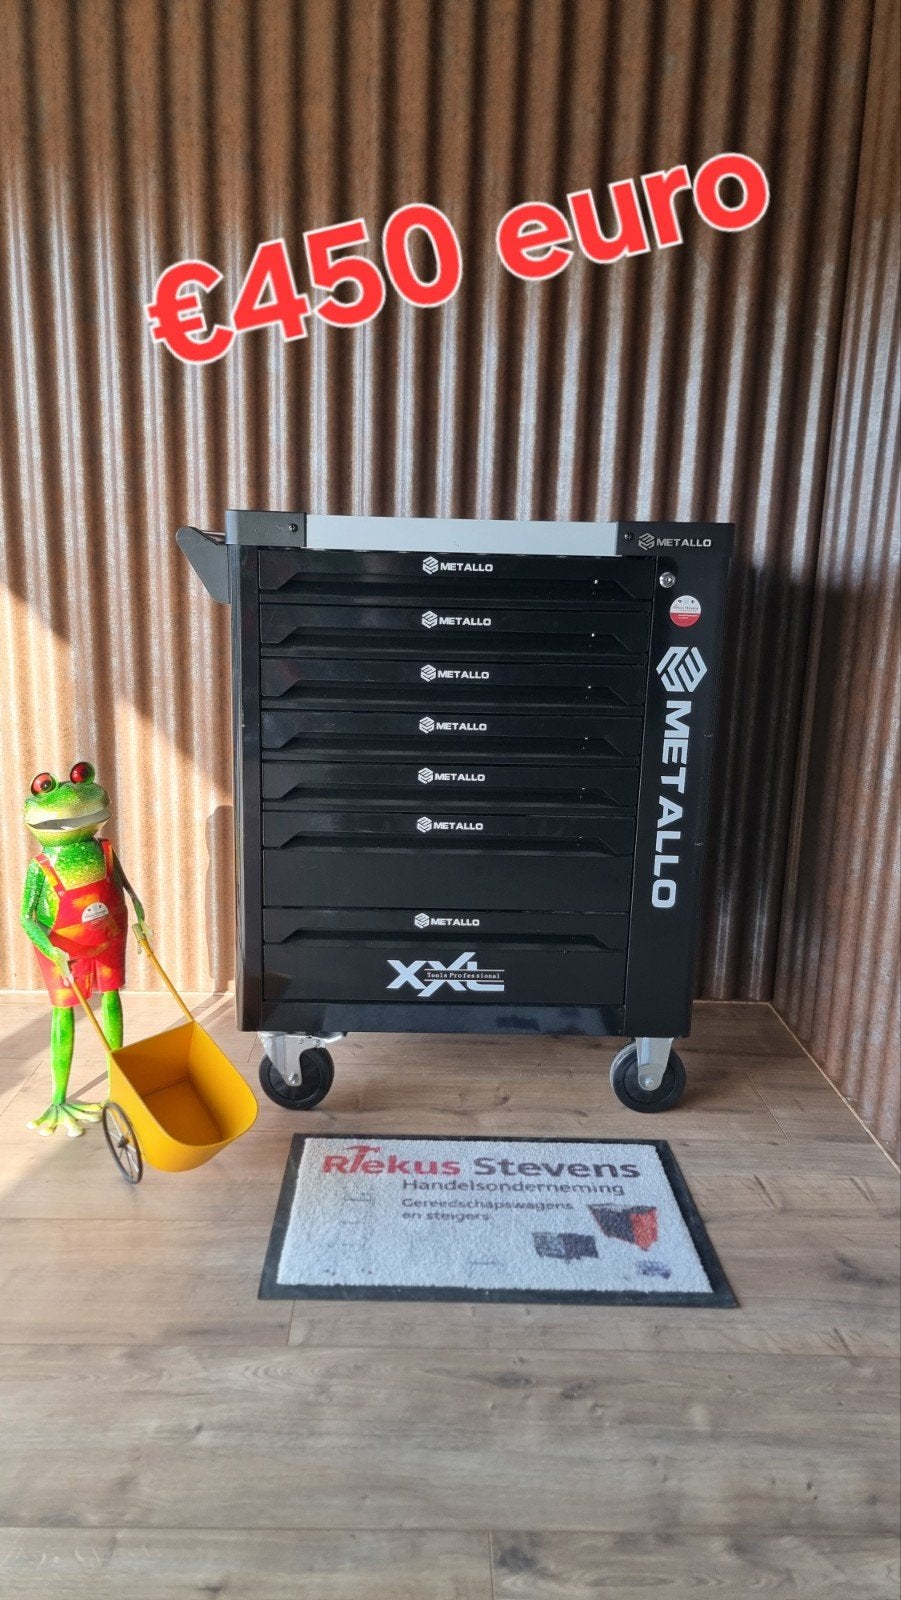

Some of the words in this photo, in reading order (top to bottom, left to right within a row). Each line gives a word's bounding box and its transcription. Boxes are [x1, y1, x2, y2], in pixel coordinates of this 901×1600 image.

[656, 538, 712, 548] METALLO
[440, 562, 494, 572] METALLO
[438, 617, 492, 626] METALLO
[437, 670, 490, 679] METALLO
[436, 722, 487, 731] METALLO
[434, 773, 486, 782] METALLO
[651, 700, 692, 909] METALLO
[433, 821, 484, 831] METALLO
[430, 917, 480, 927] METALLO
[386, 951, 505, 997] XXL
[449, 972, 500, 980] Professional
[473, 1156, 641, 1179] Stevens
[402, 1178, 625, 1197] Handelsonderneming
[402, 1198, 574, 1212] Gereedschapswagens
[402, 1212, 422, 1220] en
[426, 1211, 490, 1223] steigers
